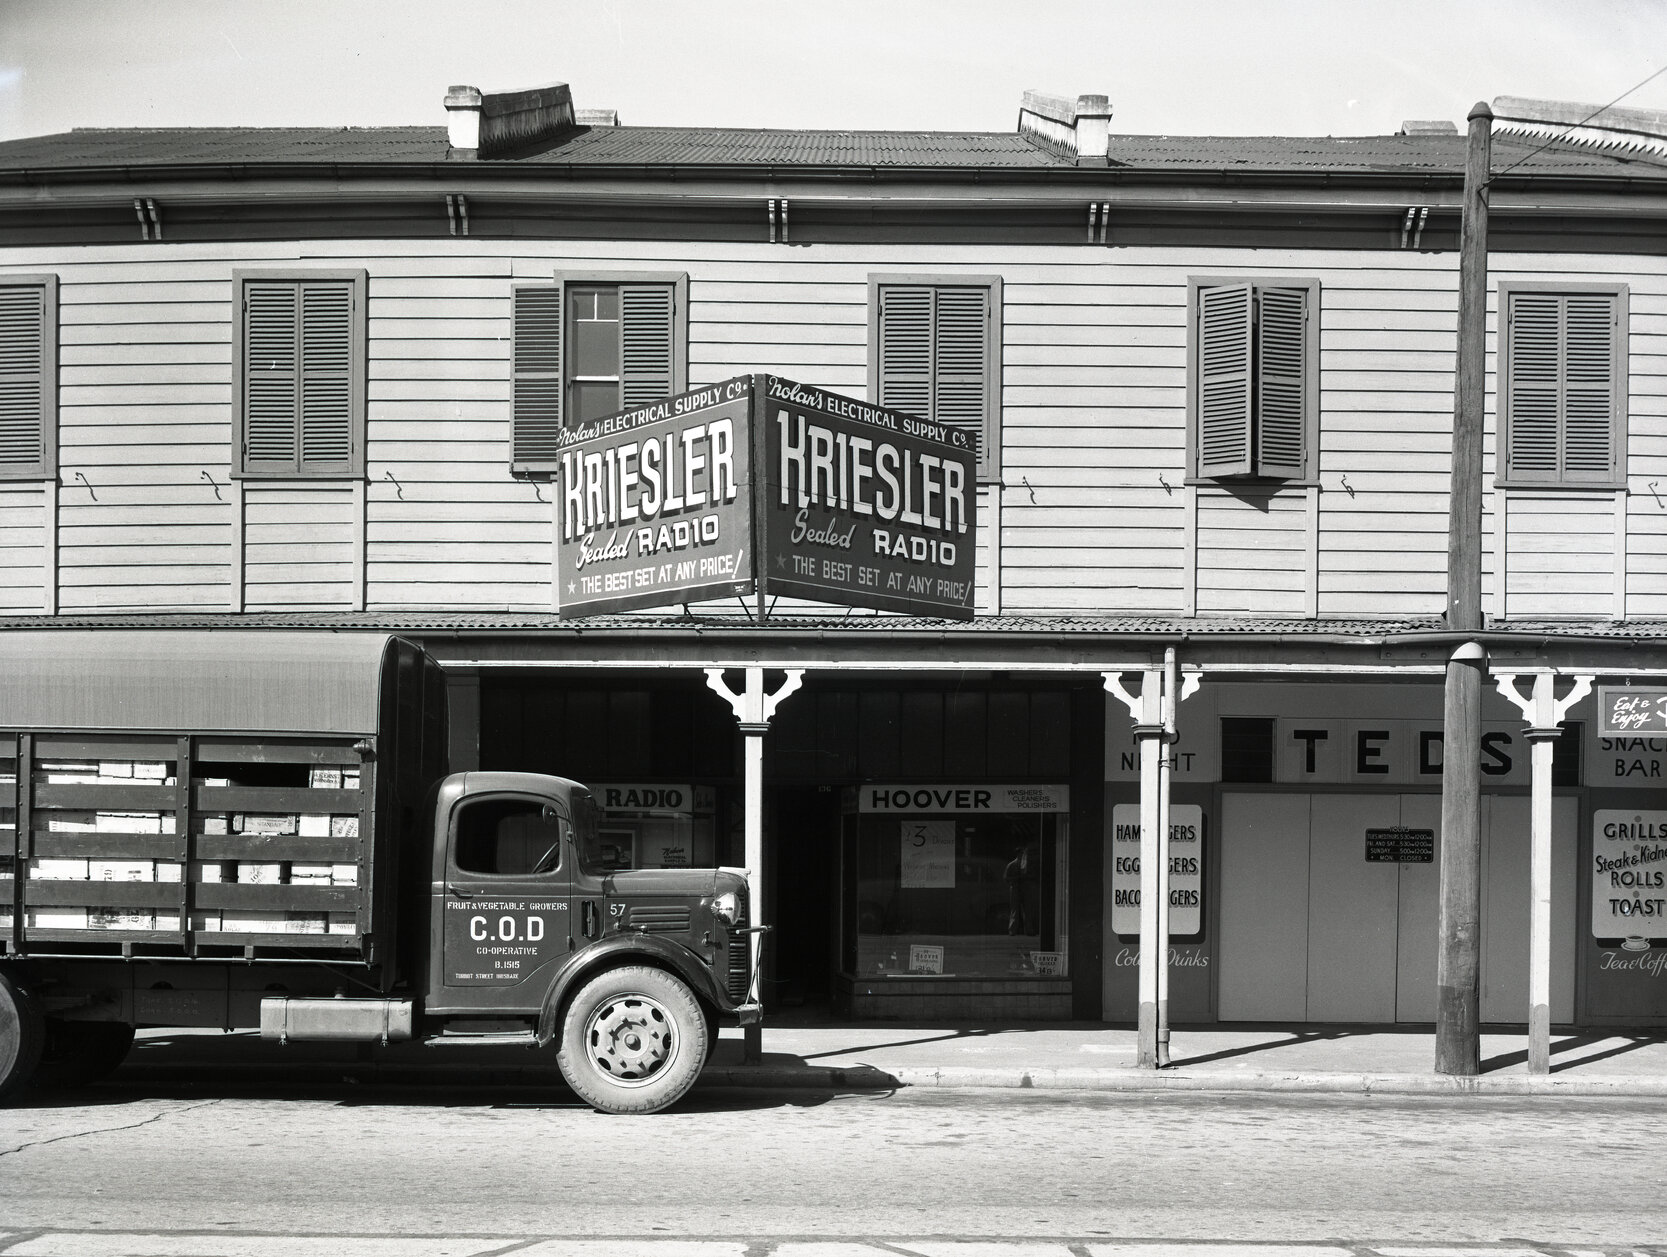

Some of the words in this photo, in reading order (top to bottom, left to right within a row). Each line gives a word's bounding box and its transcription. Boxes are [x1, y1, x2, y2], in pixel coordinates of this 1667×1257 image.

[603, 403, 671, 434] ELECTRICAL
[675, 388, 722, 414] SUPPLY
[768, 376, 823, 409] Nolan's
[827, 398, 898, 430] ELECTRICAL
[903, 419, 948, 443] SUPPLY
[562, 417, 737, 540] KRIESLER
[777, 409, 968, 534] KRIESLER
[576, 529, 634, 568] Sealed
[638, 514, 719, 553] RADIO
[791, 508, 856, 549] Sealed
[873, 528, 956, 566] RADIO
[581, 577, 602, 595] THE
[604, 573, 633, 592] BEST
[635, 567, 656, 586] SET
[658, 564, 672, 583] AT
[675, 560, 697, 580] ANY
[700, 548, 744, 579] PRICE!
[792, 554, 816, 576] THE
[823, 560, 852, 581] BEST
[858, 566, 881, 586] SET
[887, 572, 903, 590] AT
[907, 575, 933, 595] ANY
[937, 579, 972, 606] PRICE!
[1613, 697, 1640, 711] Eat
[1640, 700, 1651, 708] &
[1611, 710, 1652, 729] Enjoy
[1601, 737, 1667, 752] SNAC
[1122, 753, 1196, 771] NIHT
[1615, 758, 1661, 777] BAR
[605, 788, 683, 808] RADIO
[872, 790, 992, 808] HOOVER
[1116, 824, 1197, 841] HAMGERS
[1603, 823, 1667, 840] GRILLS
[1116, 856, 1198, 874] EGGGERS
[1596, 851, 1629, 873] Steak
[1611, 871, 1664, 888] ROLLS
[447, 902, 471, 910] FRUIT
[477, 902, 525, 910] VEGETABLE
[1115, 889, 1199, 907] BACOGERS
[1609, 899, 1665, 916] TOAST
[610, 904, 626, 915] 57
[470, 916, 544, 941] C.O.D
[476, 947, 538, 955] CO-OPERATIVE
[1115, 948, 1141, 967] Col
[1600, 951, 1628, 970] Tea
[494, 961, 520, 969] B.1515
